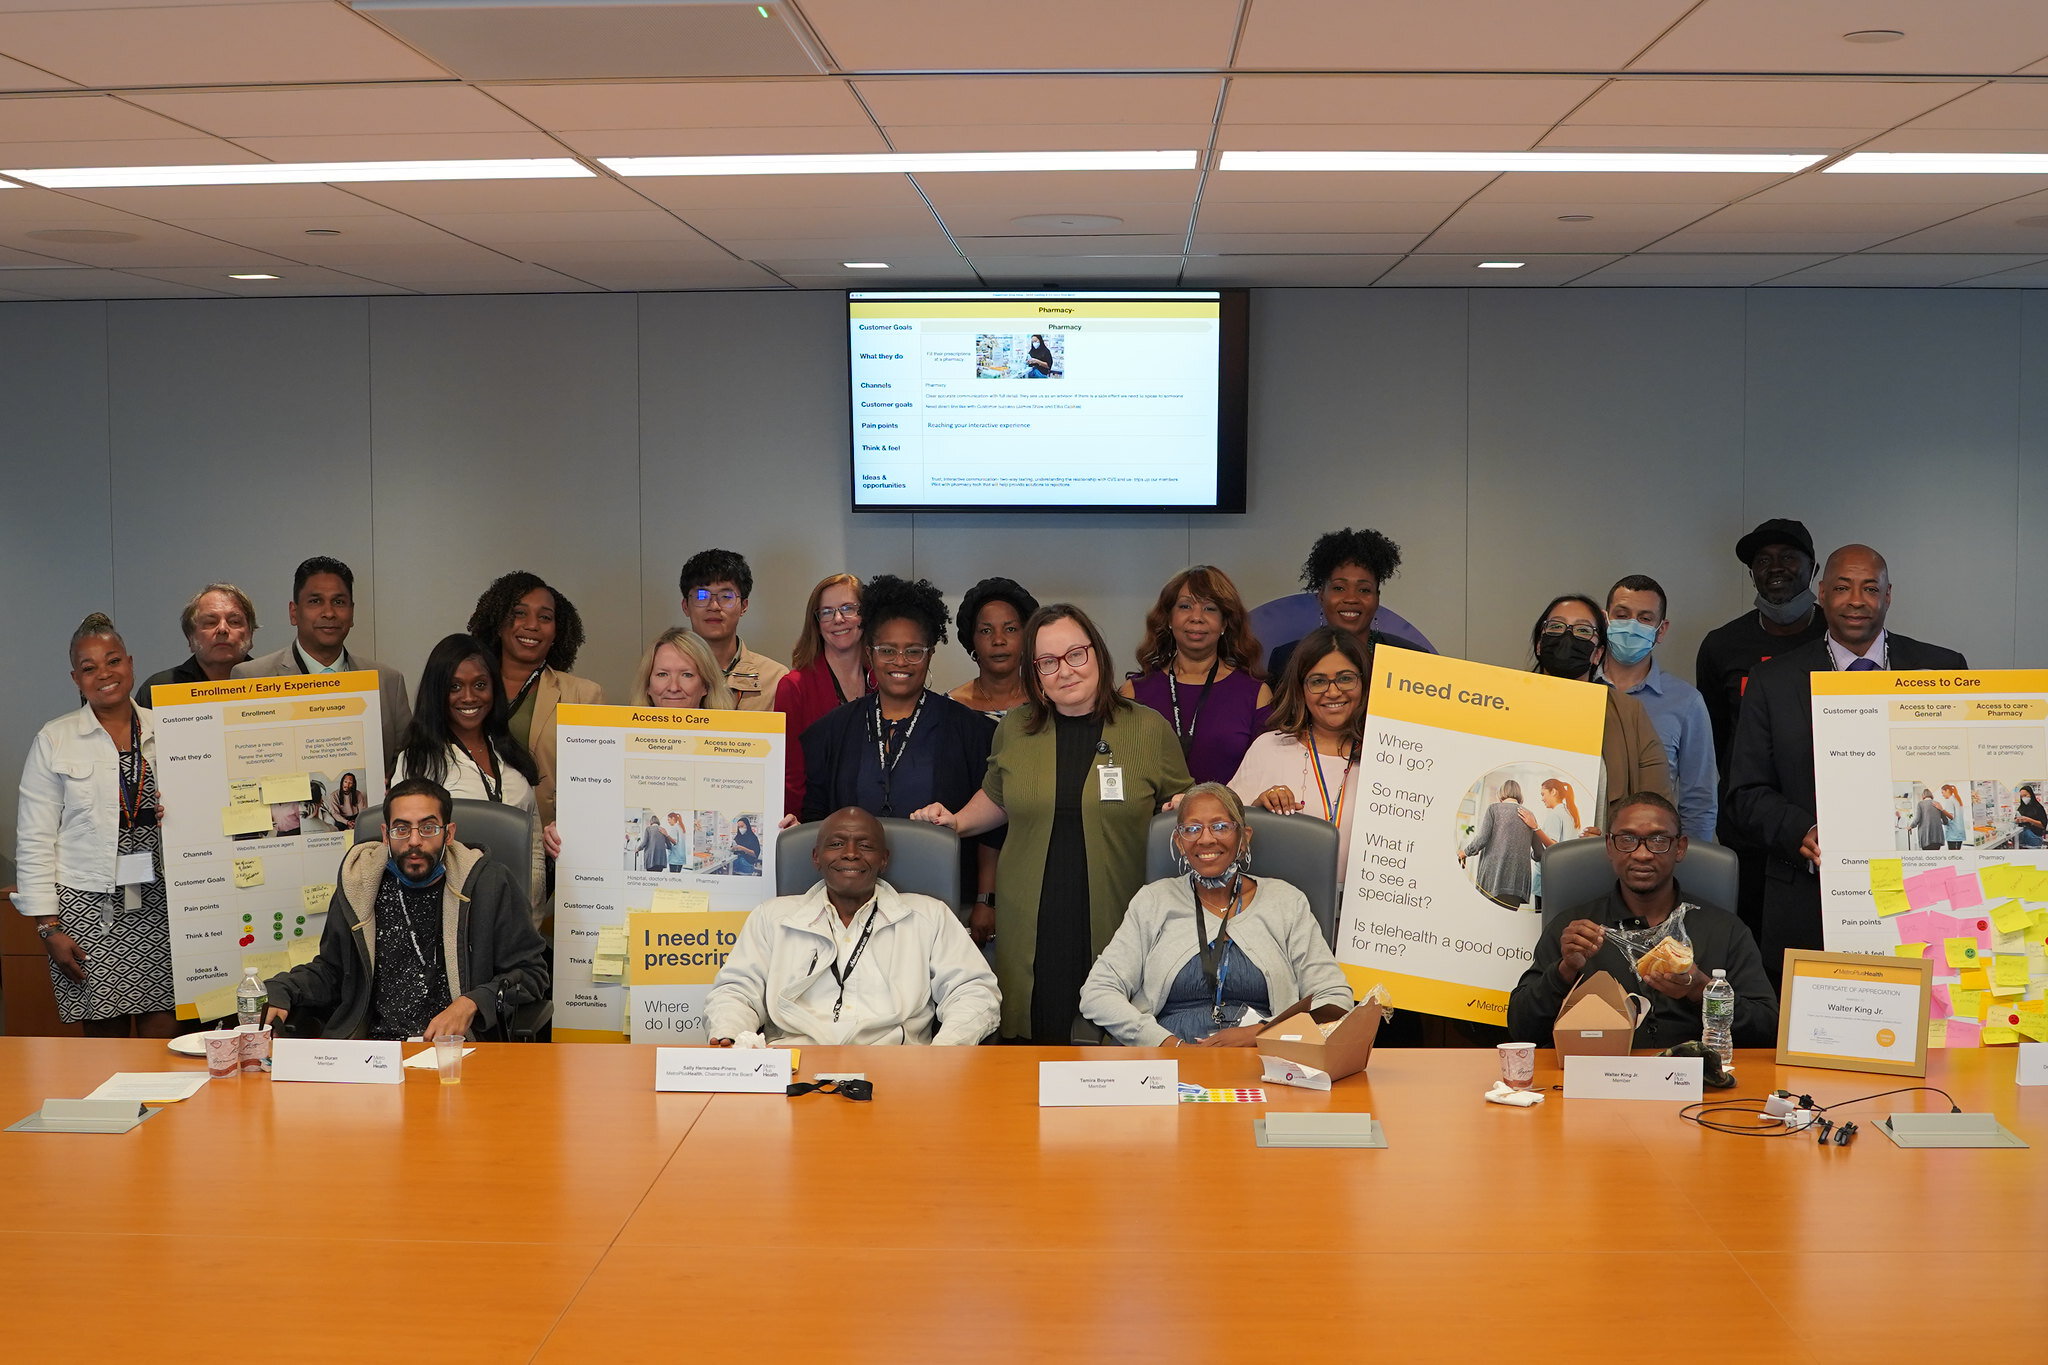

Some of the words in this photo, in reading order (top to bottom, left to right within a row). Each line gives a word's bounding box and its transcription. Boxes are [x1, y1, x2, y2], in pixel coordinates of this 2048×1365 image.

[895, 401, 913, 409] goals
[1895, 678, 1936, 687] Access
[1939, 678, 1951, 687] to
[1954, 677, 1981, 687] Care
[190, 685, 246, 698] Enrollment
[255, 683, 281, 693] Early
[284, 678, 341, 691] Experience
[1386, 672, 1393, 689] I
[1399, 675, 1452, 700] need
[1457, 690, 1511, 711] care.
[241, 709, 276, 718] Enrollment
[309, 704, 326, 713] Early
[1859, 707, 1879, 715] goals
[162, 716, 194, 724] Customer
[195, 714, 213, 722] goals
[632, 713, 669, 723] Access
[672, 714, 683, 723] to
[685, 715, 710, 724] Care
[1379, 733, 1424, 752] Where
[714, 746, 746, 754] Pharmacy
[1849, 750, 1865, 758] they
[169, 754, 187, 762] What
[1376, 751, 1395, 765] do
[1399, 754, 1403, 766] I
[1406, 758, 1434, 772] go?
[1371, 782, 1391, 797] So
[1395, 787, 1435, 808] many
[1369, 801, 1425, 821] options!
[1365, 832, 1402, 852] What
[1406, 840, 1415, 853] if
[182, 850, 213, 858] Channels
[1363, 850, 1367, 862] I
[1371, 853, 1407, 869] need
[1978, 854, 2005, 862] Pharmacy
[174, 878, 206, 887] Customer
[207, 876, 226, 884] Goals
[1361, 868, 1375, 881] to
[1379, 872, 1404, 886] see
[1408, 878, 1417, 889] a
[1358, 886, 1432, 909] specialist?
[199, 903, 220, 912] points
[563, 902, 595, 910] Customer
[645, 930, 649, 946] I
[657, 929, 709, 946] need
[716, 929, 737, 946] to
[1354, 918, 1366, 931] Is
[1370, 920, 1438, 946] telehealth
[1442, 936, 1450, 947] a
[1455, 938, 1493, 954] good
[1496, 946, 1535, 962] optio
[1351, 936, 1371, 950] for
[1375, 940, 1407, 957] me?
[569, 957, 586, 965] Think
[645, 949, 731, 970] prescrip
[186, 971, 228, 982] opportunities
[1839, 969, 1883, 977] MetroPlusHealth
[1812, 984, 1848, 992] CERTIFICATE
[1858, 987, 1901, 996] APPRECIATION
[645, 1001, 689, 1013] Where
[1476, 1000, 1509, 1013] MetroP
[1828, 1004, 1852, 1013] Walter
[1854, 1006, 1872, 1015] King
[1874, 1007, 1883, 1015] Jr.
[645, 1018, 663, 1030] do
[667, 1018, 671, 1029] I
[675, 1017, 701, 1032] go?
